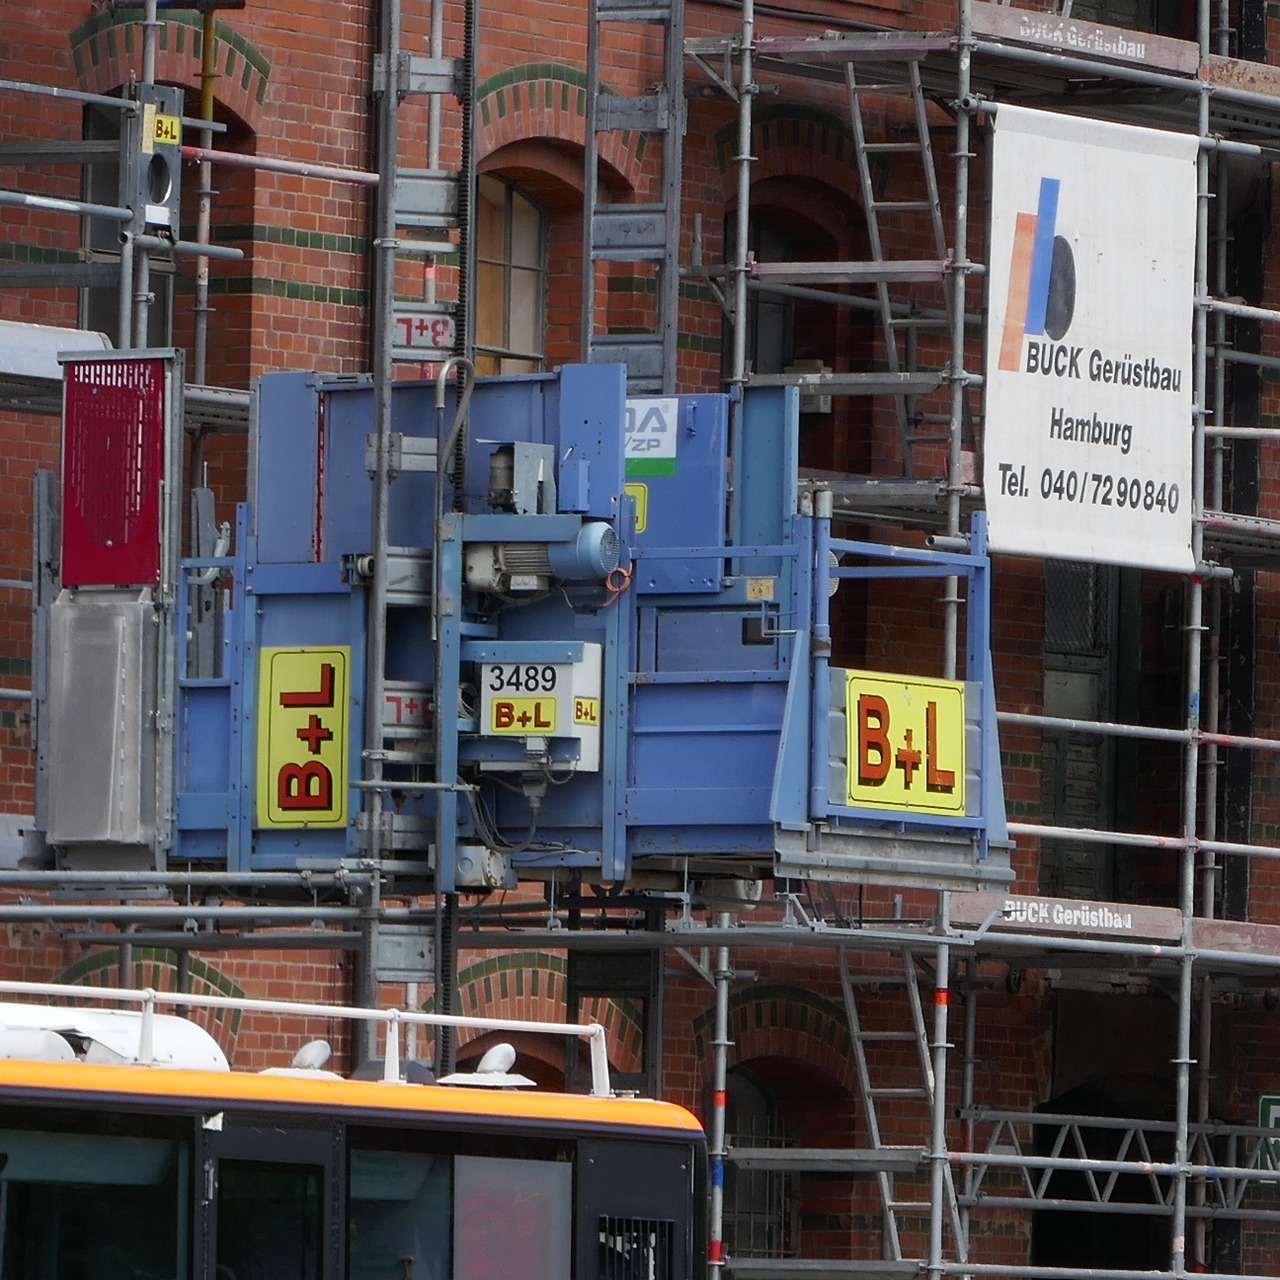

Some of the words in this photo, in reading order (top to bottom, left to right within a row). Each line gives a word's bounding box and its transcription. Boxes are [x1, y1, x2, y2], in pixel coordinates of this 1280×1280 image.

[155, 118, 178, 140] B+L
[1026, 341, 1085, 379] BUCK
[1089, 349, 1182, 393] Gerüstbau
[1049, 407, 1133, 455] Hamburg
[998, 463, 1029, 497] Tel.
[489, 665, 557, 692] 3489
[495, 701, 552, 728] B+L
[575, 701, 597, 721] B+L
[278, 663, 336, 811] B+L
[857, 693, 956, 795] B+L
[1004, 900, 1050, 924] BUCK
[1052, 904, 1132, 929] Gerüstbau
